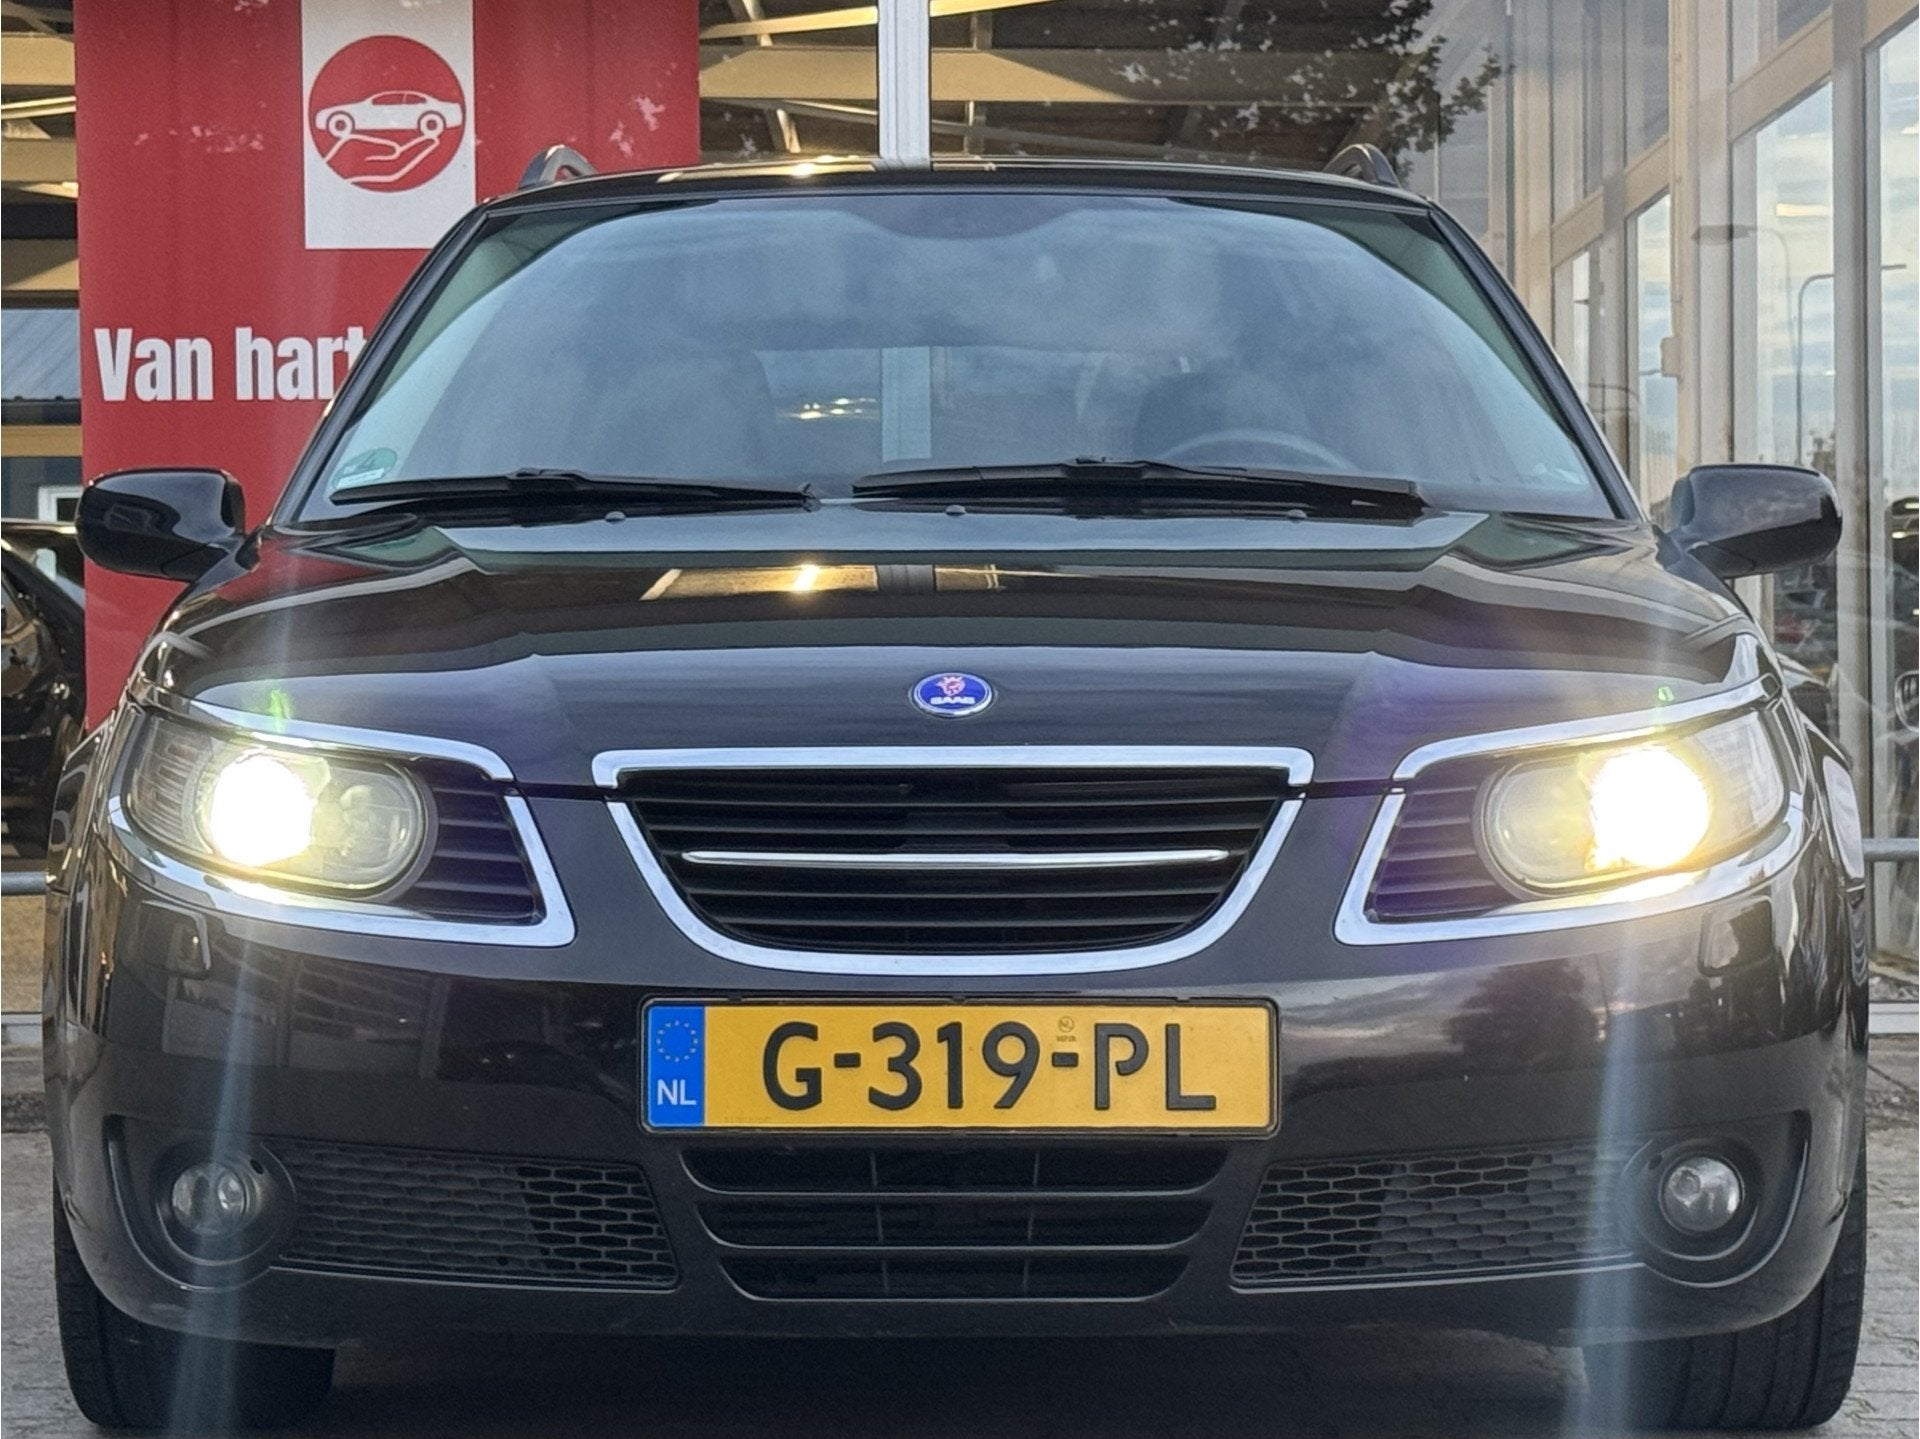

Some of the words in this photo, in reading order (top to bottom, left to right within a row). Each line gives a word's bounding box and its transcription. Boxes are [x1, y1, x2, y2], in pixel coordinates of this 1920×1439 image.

[94, 328, 213, 401] Van
[657, 1079, 697, 1105] NL
[763, 1021, 1216, 1110] G-319-PL
